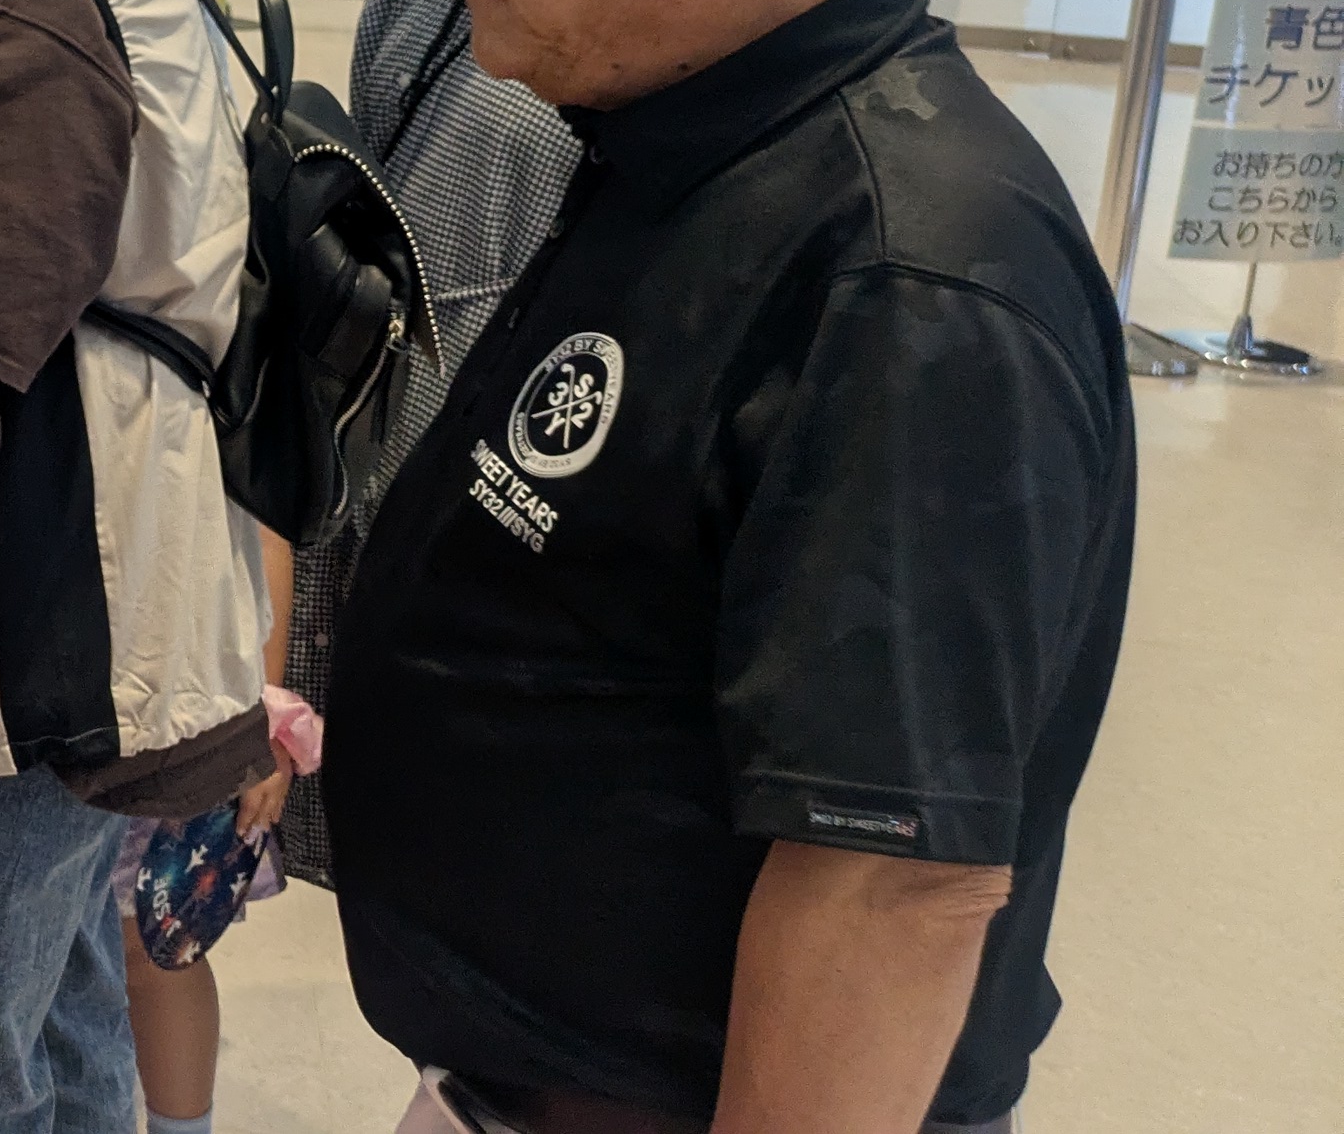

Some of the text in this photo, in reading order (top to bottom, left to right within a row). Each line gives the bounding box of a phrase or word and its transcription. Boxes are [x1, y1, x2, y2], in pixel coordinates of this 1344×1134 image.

[1208, 187, 1337, 212] こちらから
[505, 475, 558, 533] YEARS
